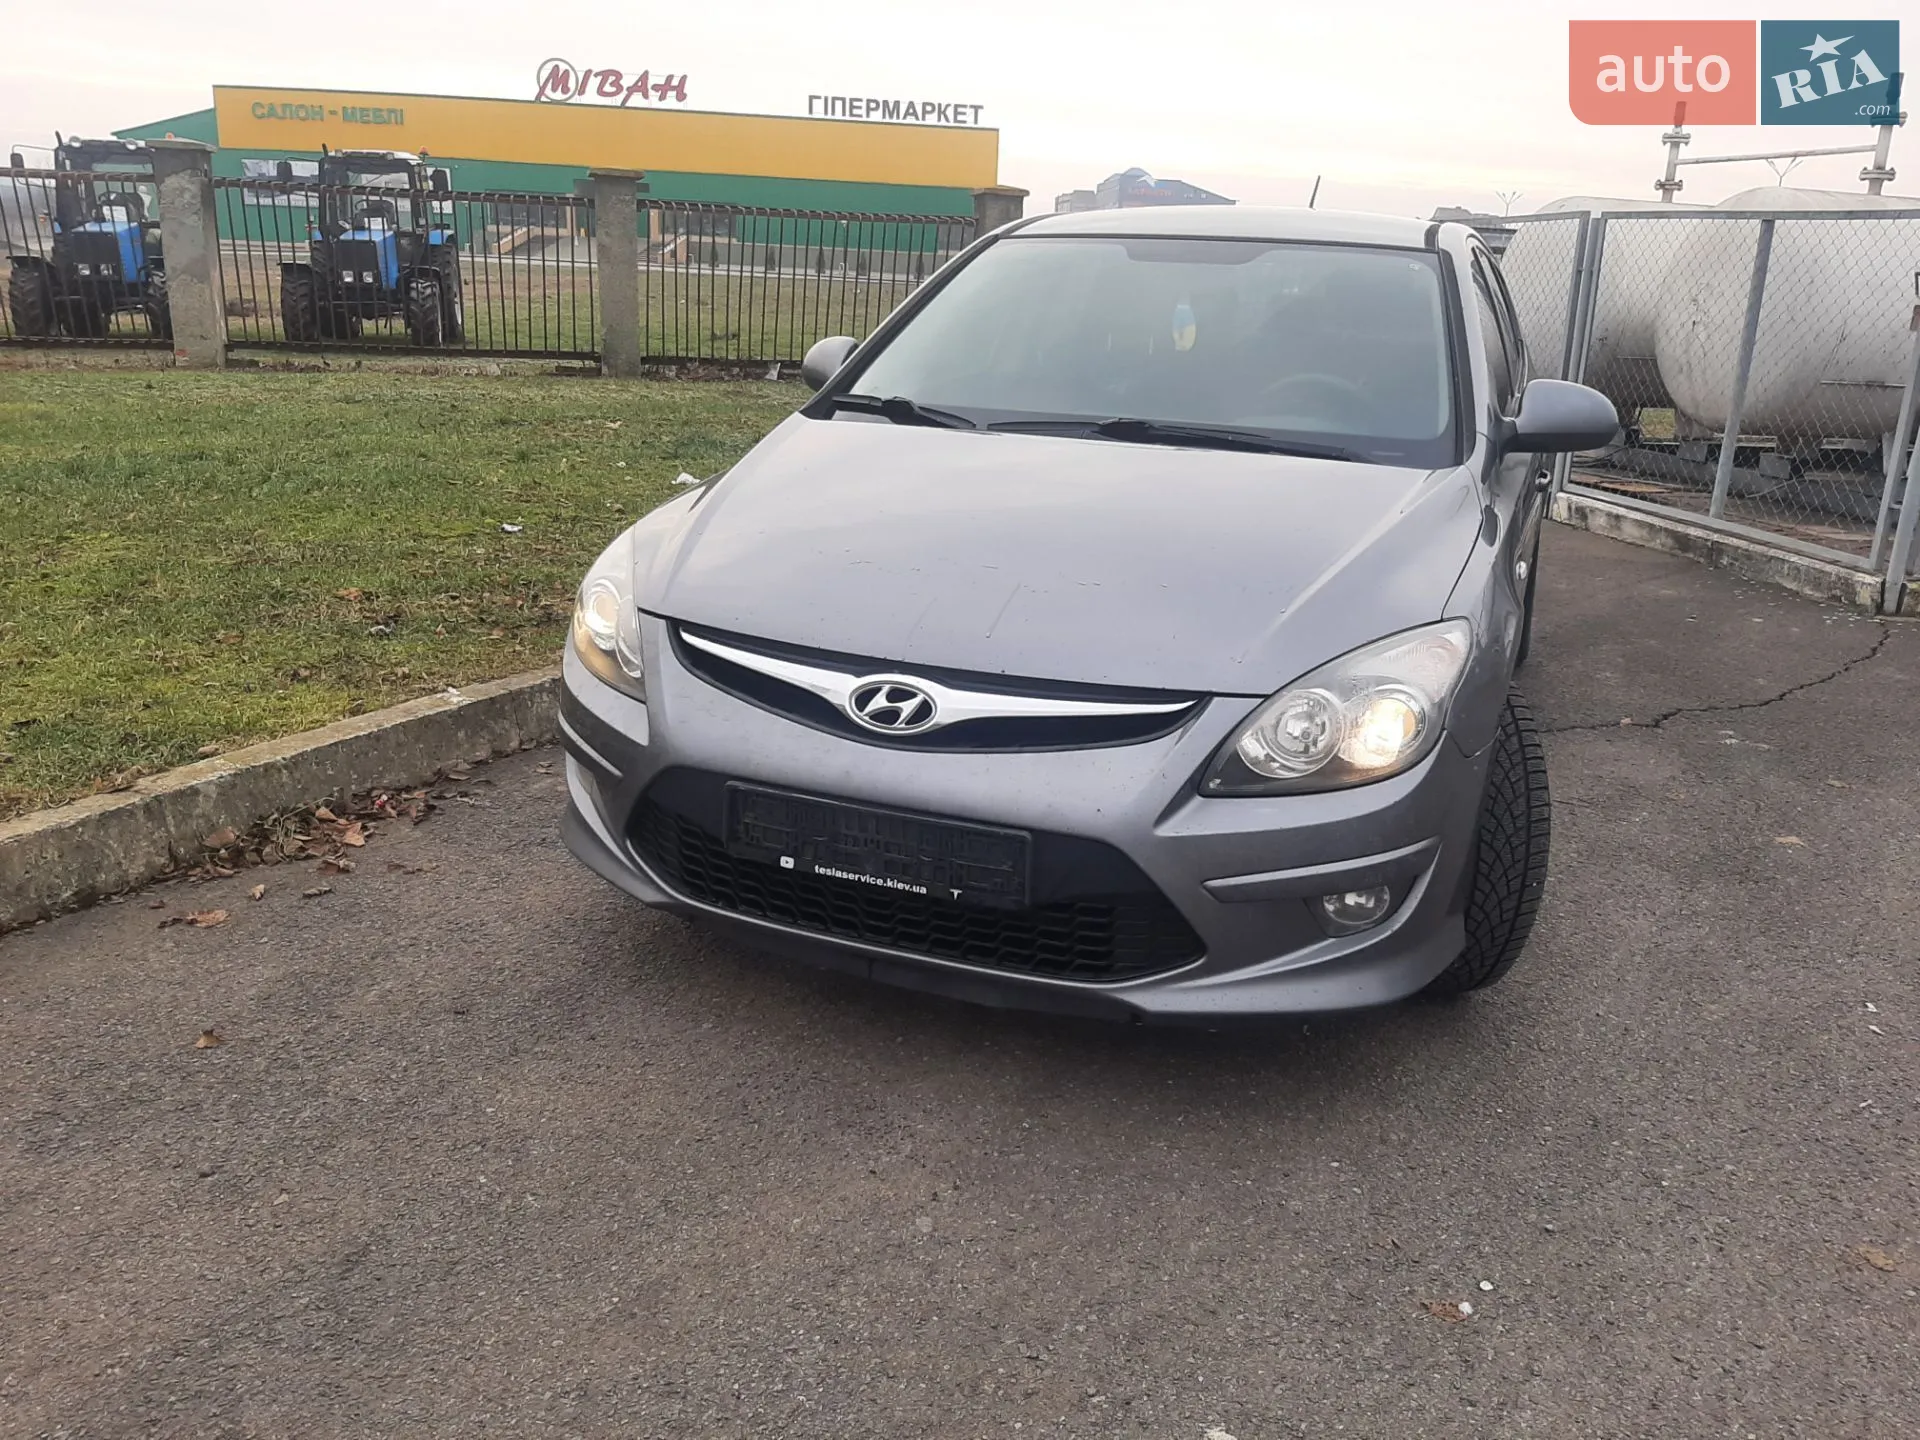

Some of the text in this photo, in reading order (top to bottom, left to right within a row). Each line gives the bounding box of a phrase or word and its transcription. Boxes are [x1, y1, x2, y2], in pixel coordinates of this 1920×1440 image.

[534, 62, 688, 107] МІВАН
[251, 102, 325, 122] САЛОН
[342, 106, 404, 125] МЕБЛІ
[808, 95, 984, 125] ГІПЕРМАРКЕТ
[814, 864, 928, 895] teslaservice.kiev.ua
